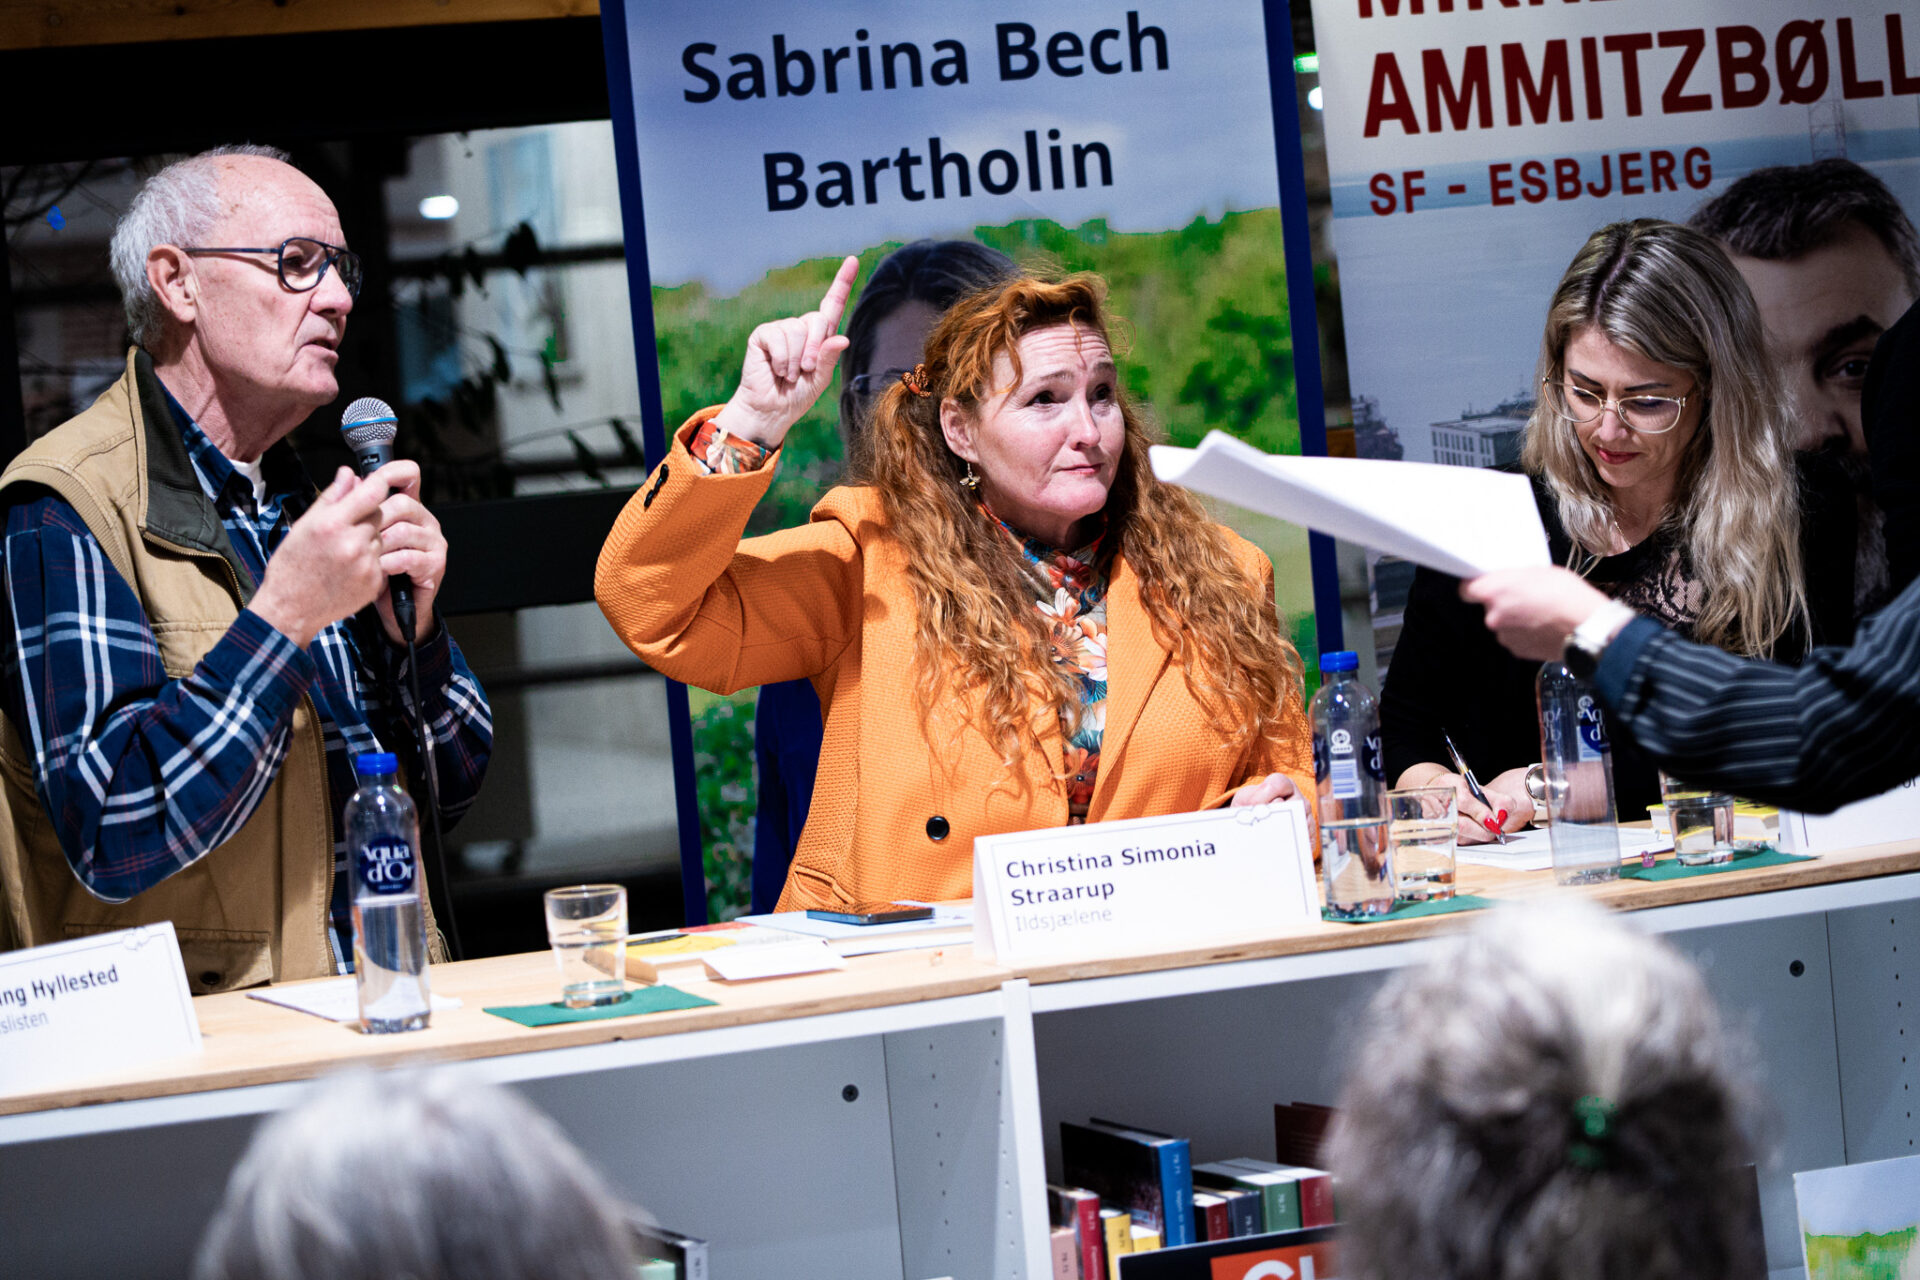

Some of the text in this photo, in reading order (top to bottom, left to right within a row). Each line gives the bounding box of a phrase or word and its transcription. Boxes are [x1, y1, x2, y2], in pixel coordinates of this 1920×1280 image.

[681, 10, 1169, 104] Sabrina Bech
[1363, 13, 1920, 138] AMMITZBØLL
[763, 128, 1113, 212] Bartholin
[1369, 147, 1714, 216] SF - ESBJERG
[1006, 839, 1217, 879] Christina Simonia
[1011, 881, 1116, 907] Straarup
[1015, 907, 1113, 932] Ildsjælene
[31, 964, 120, 1001] Hyllested
[0, 1011, 49, 1035] slisten
